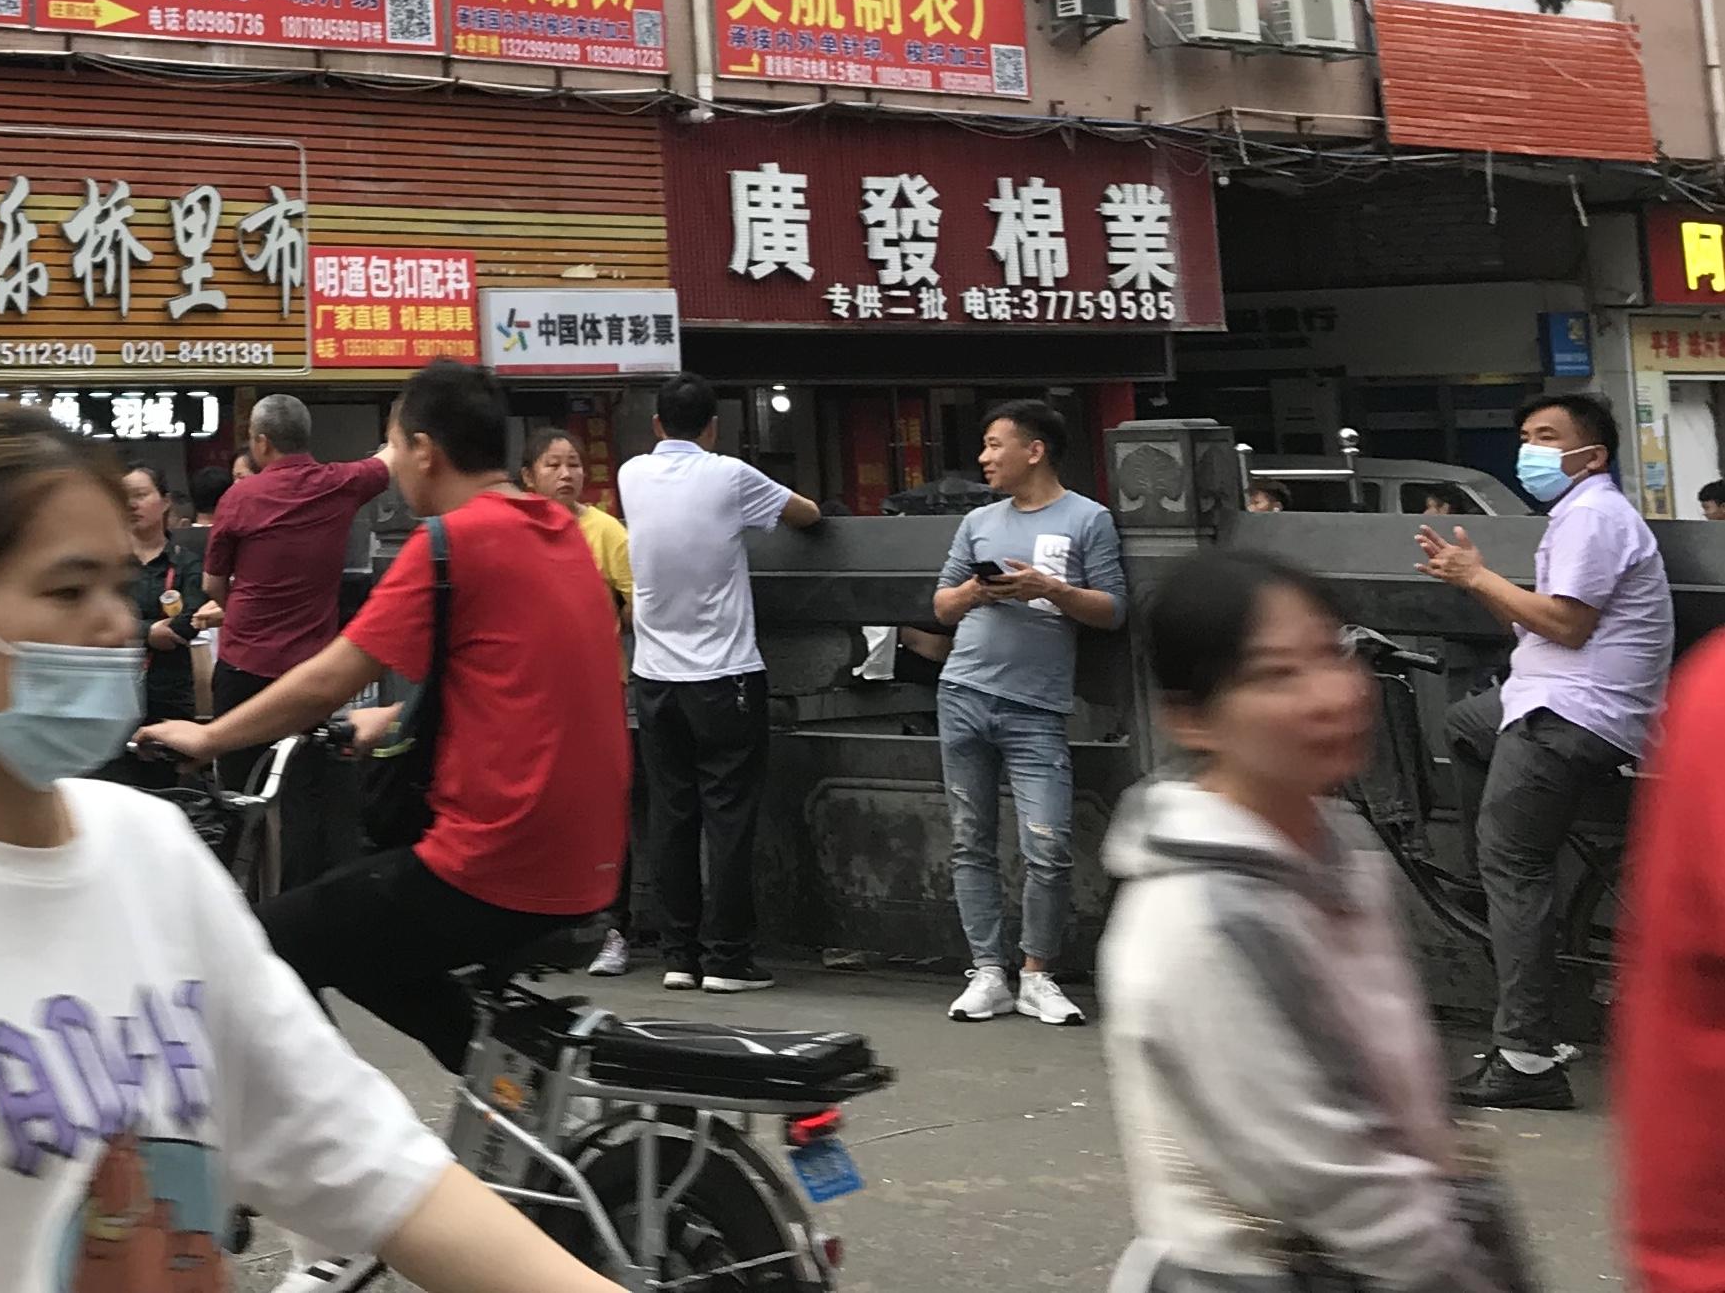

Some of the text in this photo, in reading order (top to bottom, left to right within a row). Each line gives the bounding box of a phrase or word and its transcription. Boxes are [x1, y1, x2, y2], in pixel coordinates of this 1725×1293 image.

[729, 162, 1177, 289] 廣發棉業
[314, 256, 471, 300] 明通包扣配料
[826, 283, 947, 320] 专供二批
[538, 312, 675, 347] 中国体育彩票
[121, 341, 275, 367] 020-84131381
